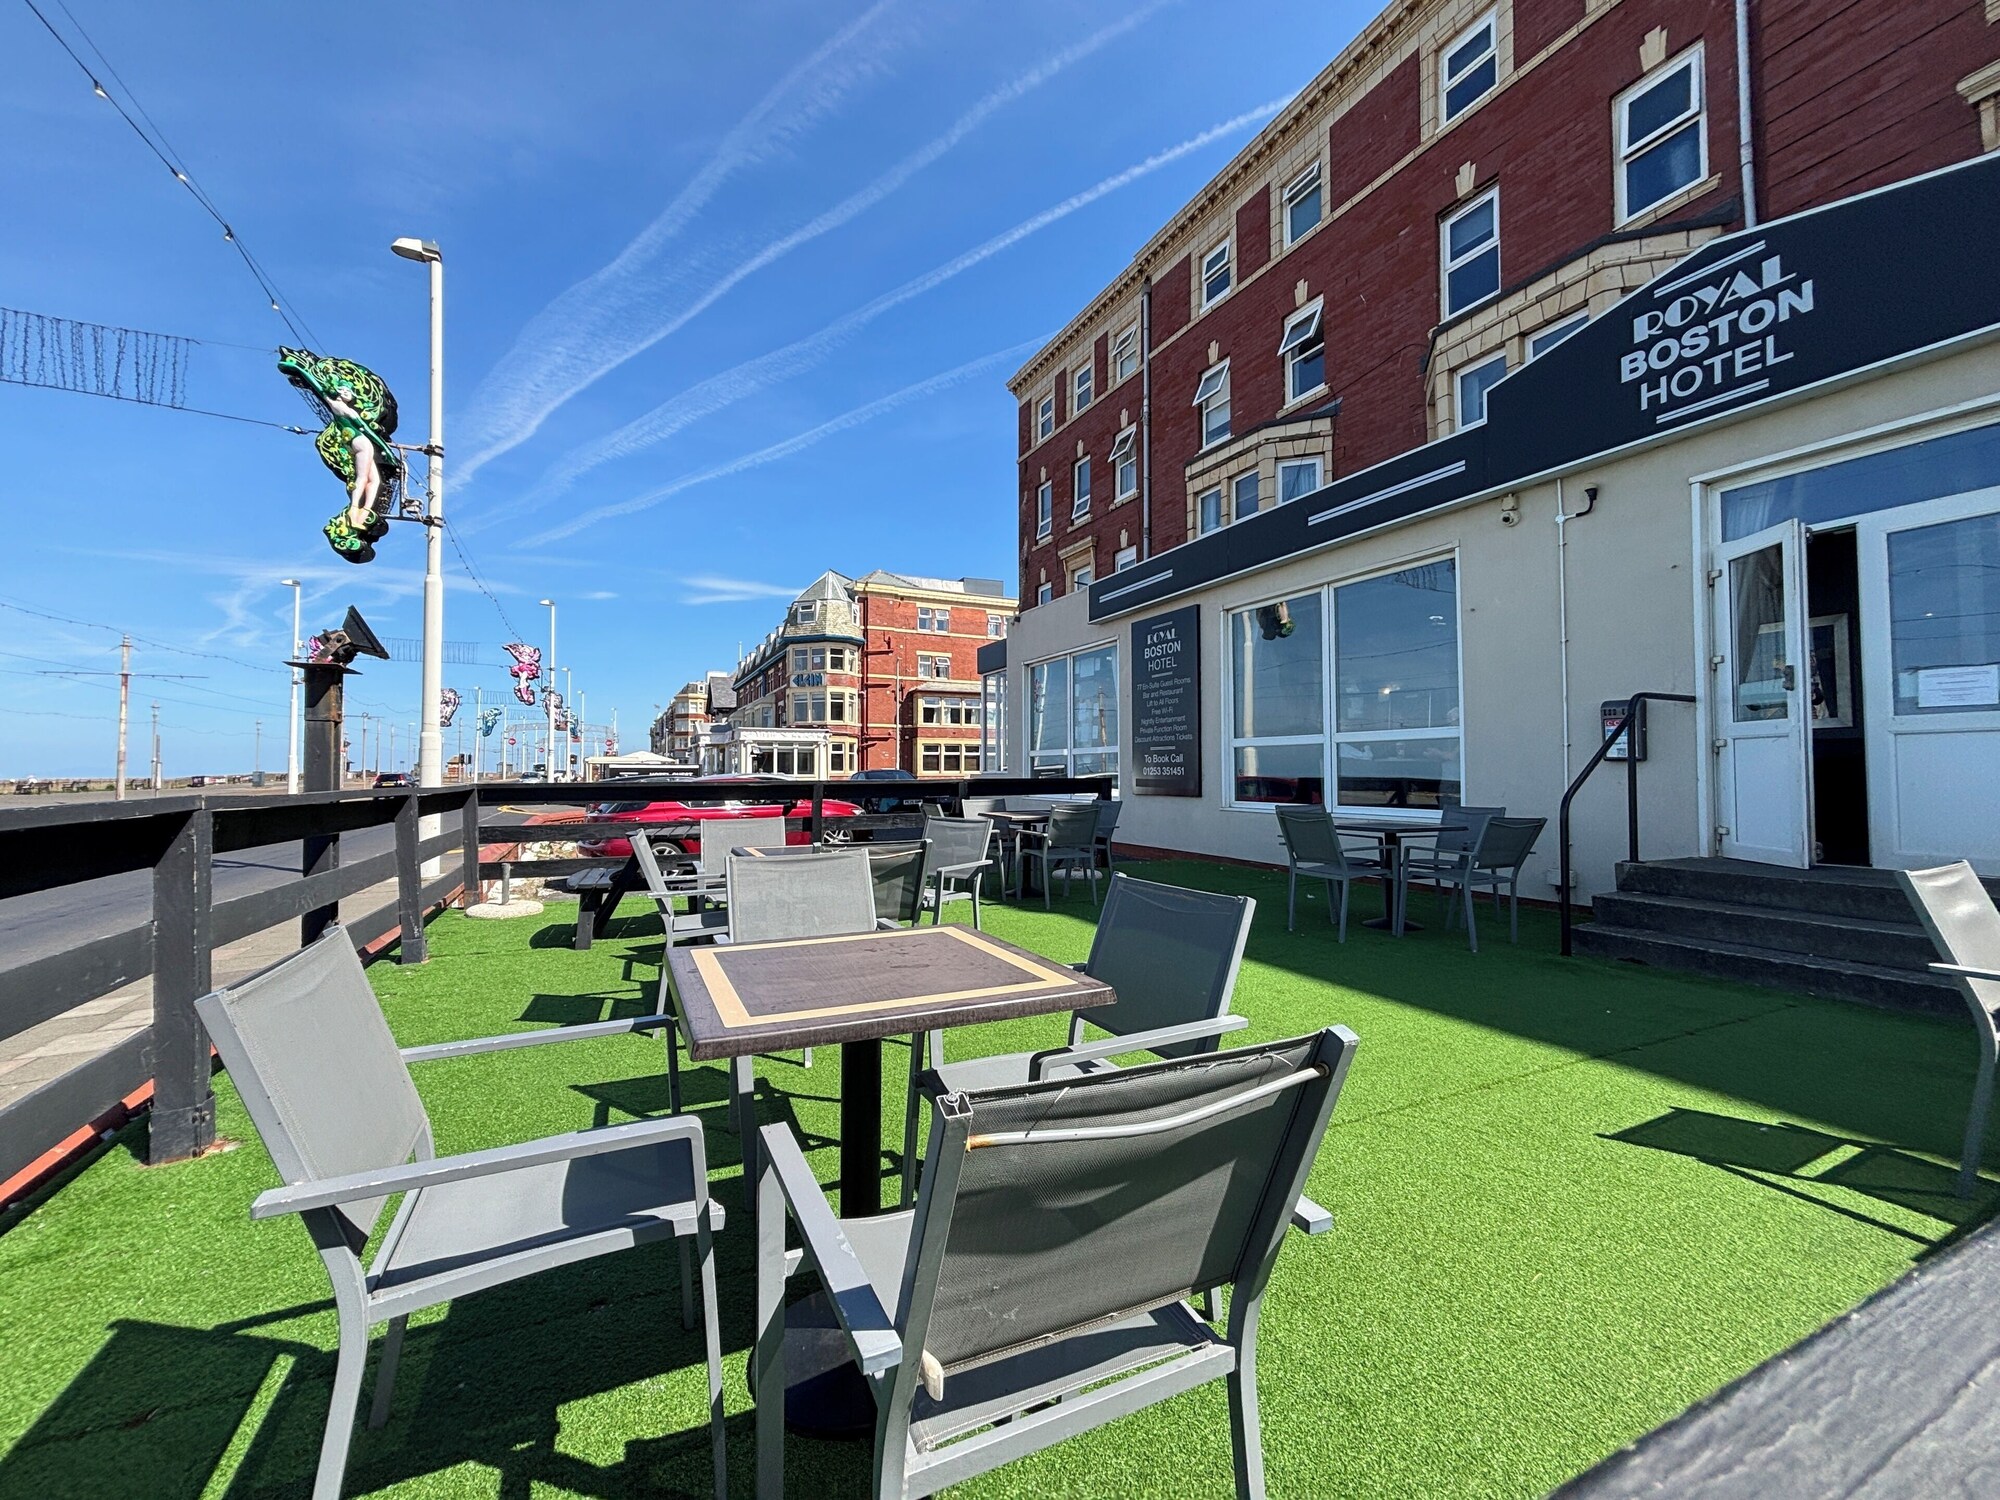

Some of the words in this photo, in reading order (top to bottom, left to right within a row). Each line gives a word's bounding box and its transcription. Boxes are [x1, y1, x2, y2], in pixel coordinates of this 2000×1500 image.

[1633, 254, 1797, 344] ROYAL
[1621, 279, 1814, 383] BOSTON
[1640, 334, 1794, 411] HOTEL
[1147, 628, 1177, 644] ROYAL
[1144, 640, 1181, 659] BOSTON
[1148, 656, 1177, 671] HOTEL
[792, 673, 823, 687] ELGIN
[1174, 677, 1191, 685] Rooms
[1142, 691, 1150, 699] Bar
[1160, 687, 1183, 696] Restaurant
[1140, 718, 1154, 726] Nightly
[1155, 715, 1186, 724] Entertainment
[1175, 733, 1193, 741] Tickets
[1144, 754, 1151, 763] To
[1152, 753, 1169, 763] Book
[1170, 753, 1184, 762] Call
[1142, 766, 1161, 776] 01253
[1162, 766, 1185, 776] 351451
